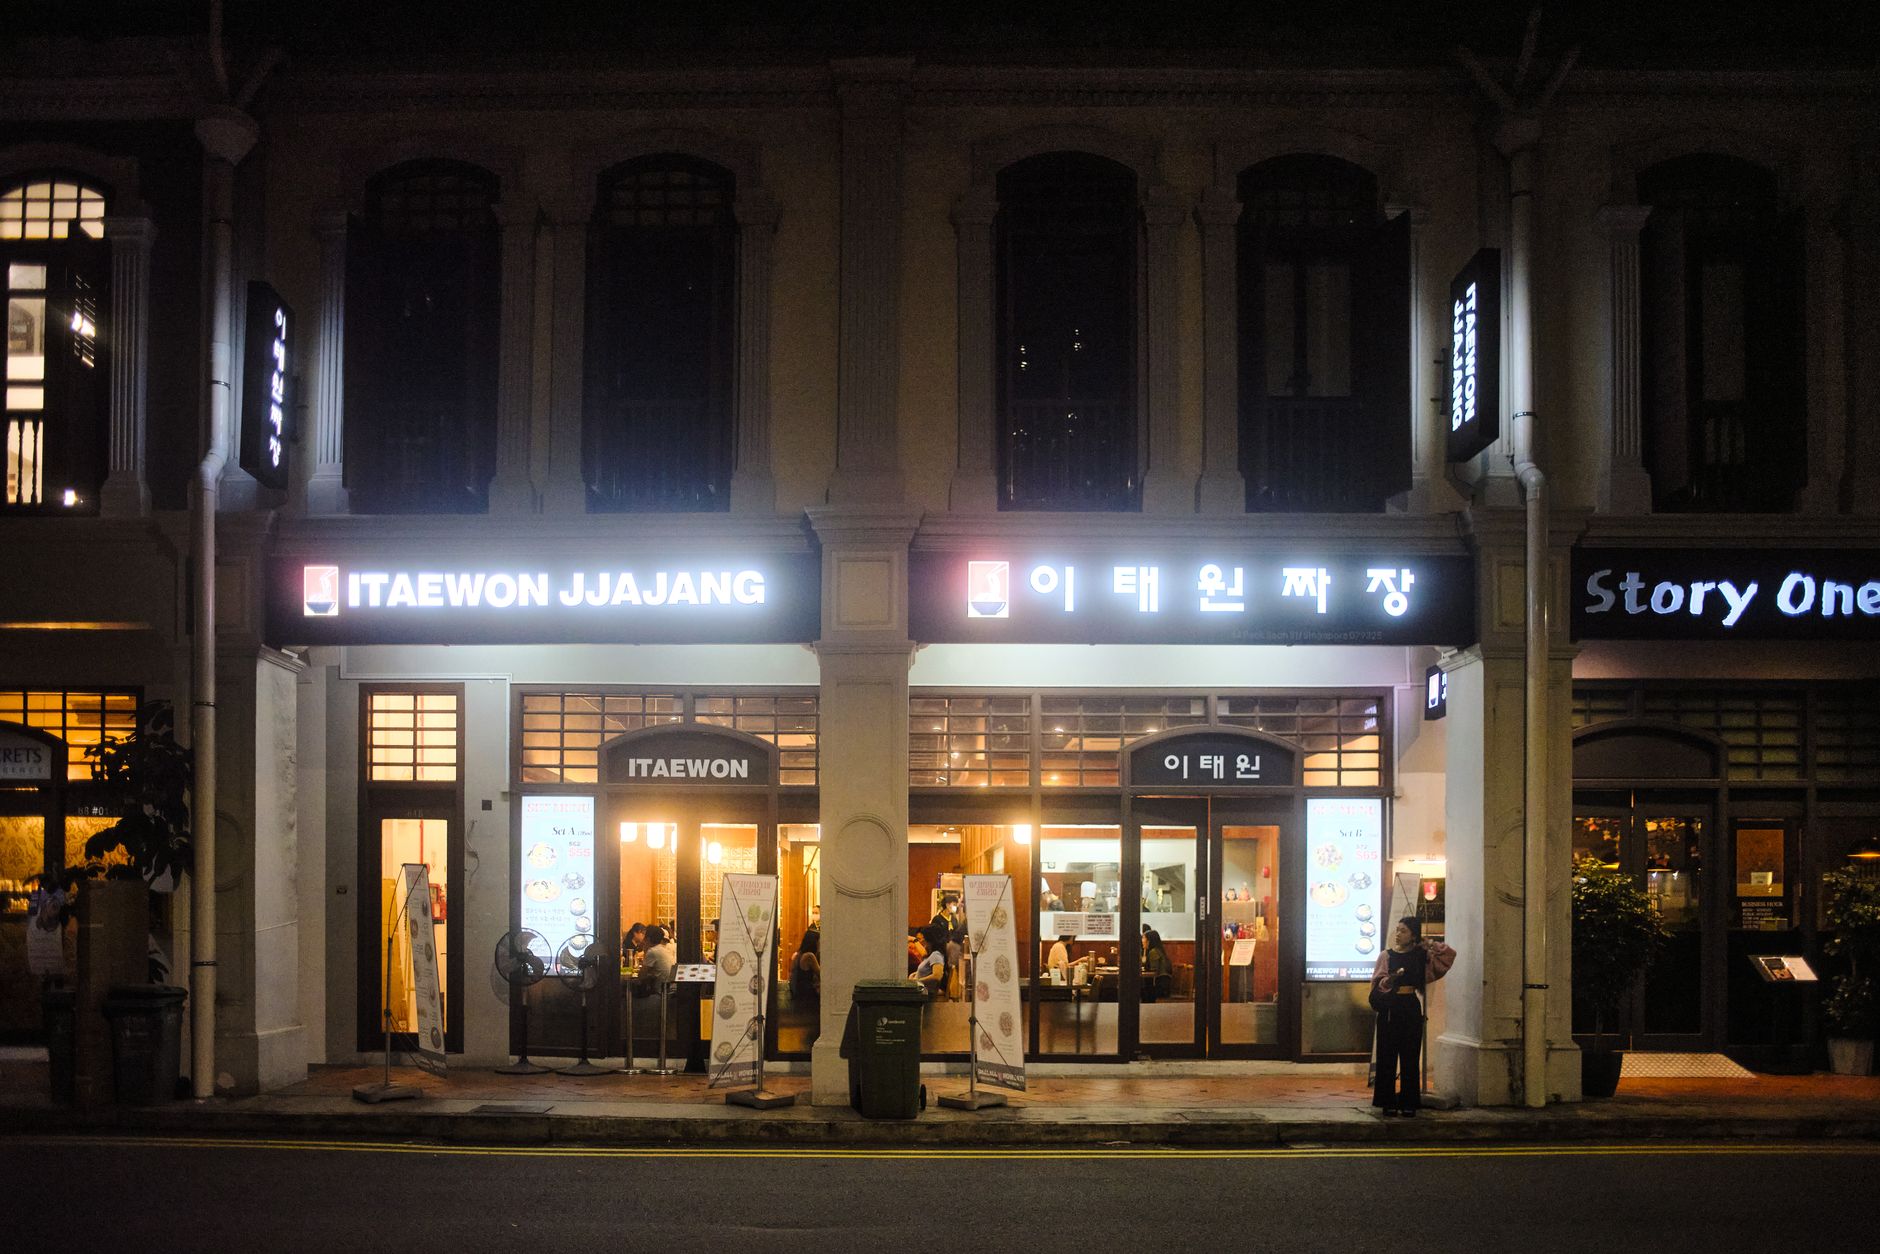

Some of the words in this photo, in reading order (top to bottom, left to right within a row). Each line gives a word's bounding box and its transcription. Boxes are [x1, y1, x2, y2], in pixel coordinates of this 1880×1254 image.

[1453, 299, 1463, 431] JJAJANG
[1465, 282, 1475, 422] ITAEWON
[347, 573, 549, 608] ITAEWON
[560, 571, 766, 606] JJAJANG
[1585, 569, 1758, 627] Story
[1777, 571, 1880, 616] One
[0, 747, 42, 764] RETS
[628, 758, 749, 779] ITAEWON
